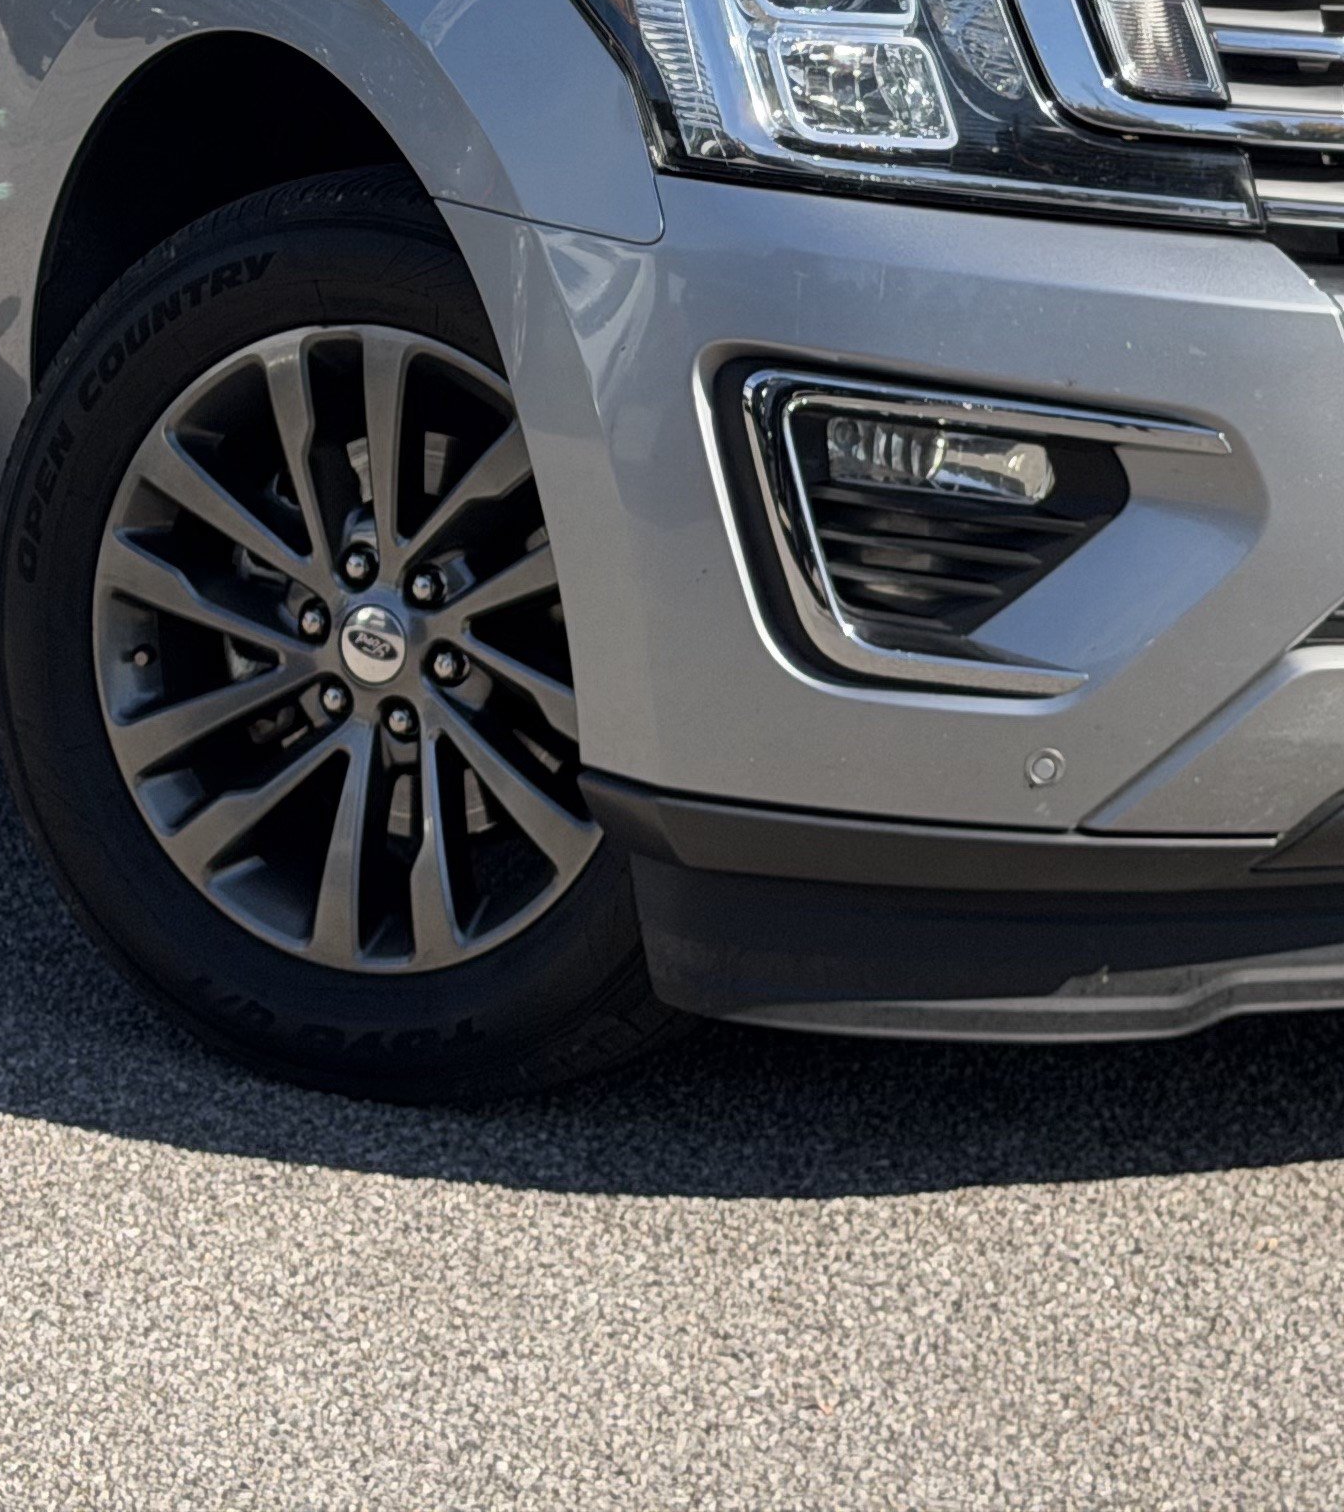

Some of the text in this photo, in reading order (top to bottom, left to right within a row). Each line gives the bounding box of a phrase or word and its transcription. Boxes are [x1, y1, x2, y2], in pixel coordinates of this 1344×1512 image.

[18, 251, 277, 584] OPEN COUNTRY
[354, 631, 392, 658] Ford
